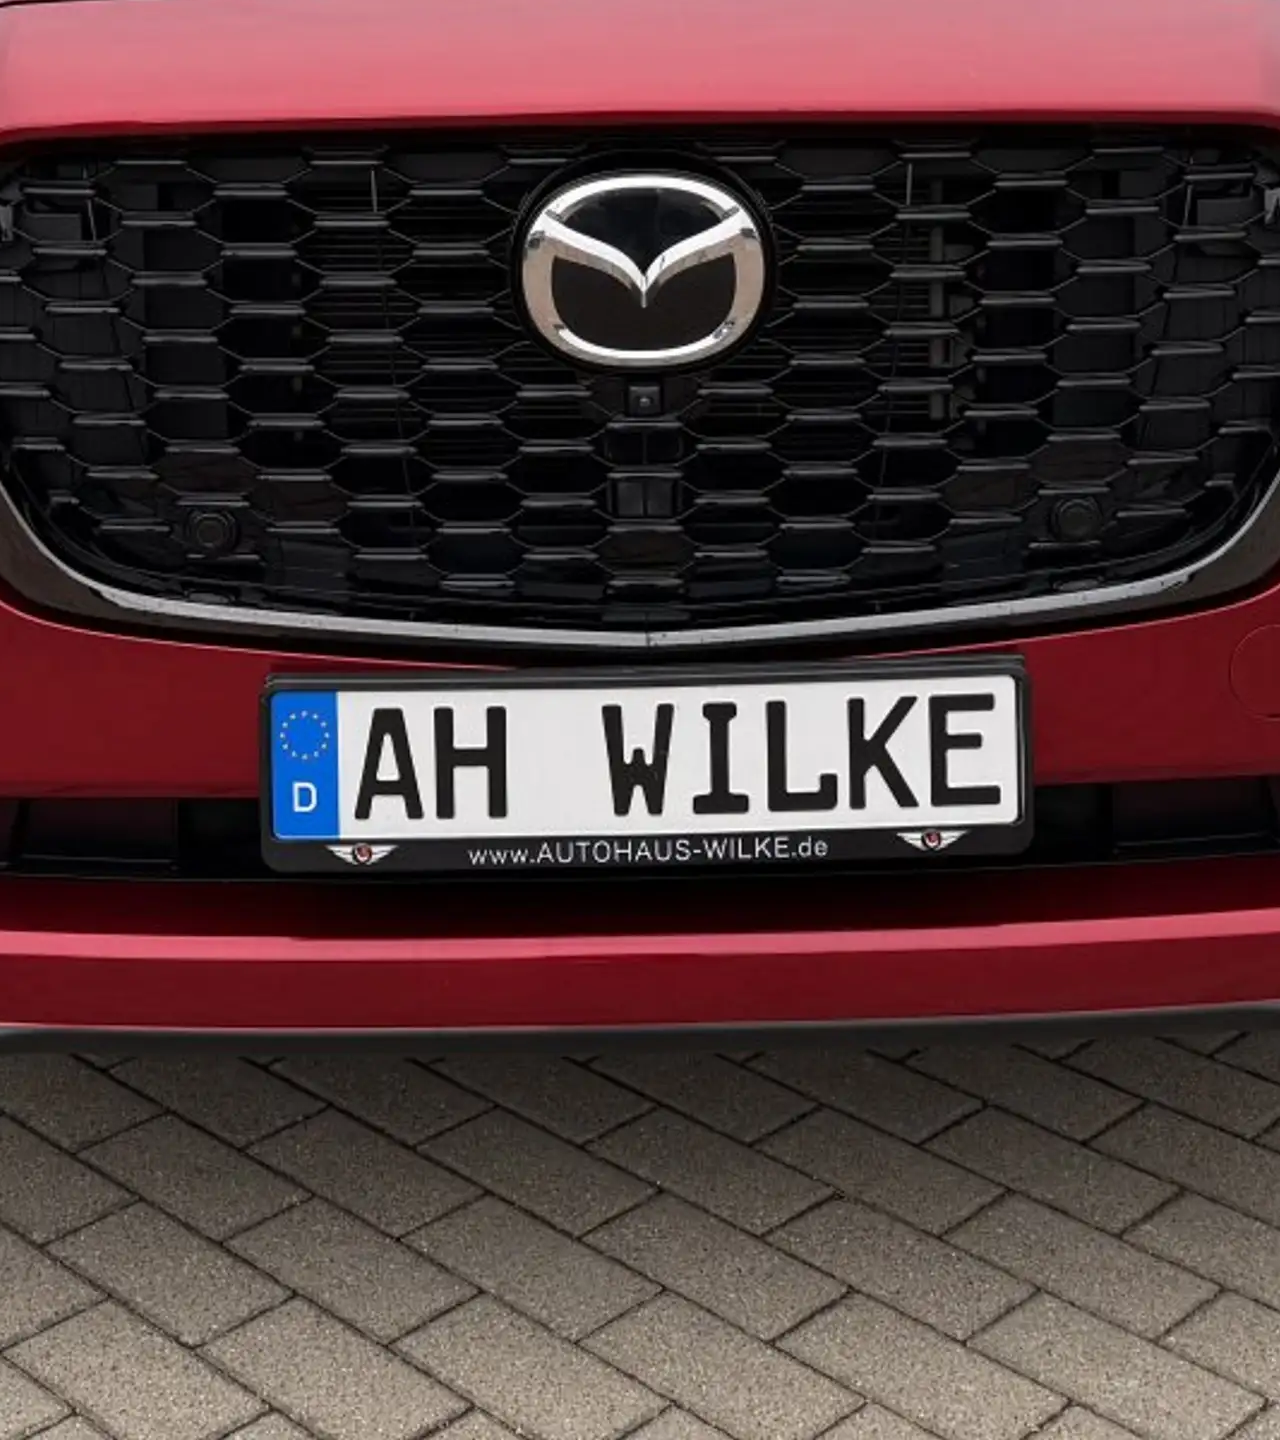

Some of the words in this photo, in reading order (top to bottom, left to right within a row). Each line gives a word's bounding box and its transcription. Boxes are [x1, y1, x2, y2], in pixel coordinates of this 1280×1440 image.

[353, 705, 508, 821] AH
[601, 693, 1002, 816] WILKE
[293, 781, 317, 814] D
[467, 836, 829, 865] www.AUTOHAUS-WILKE.de
